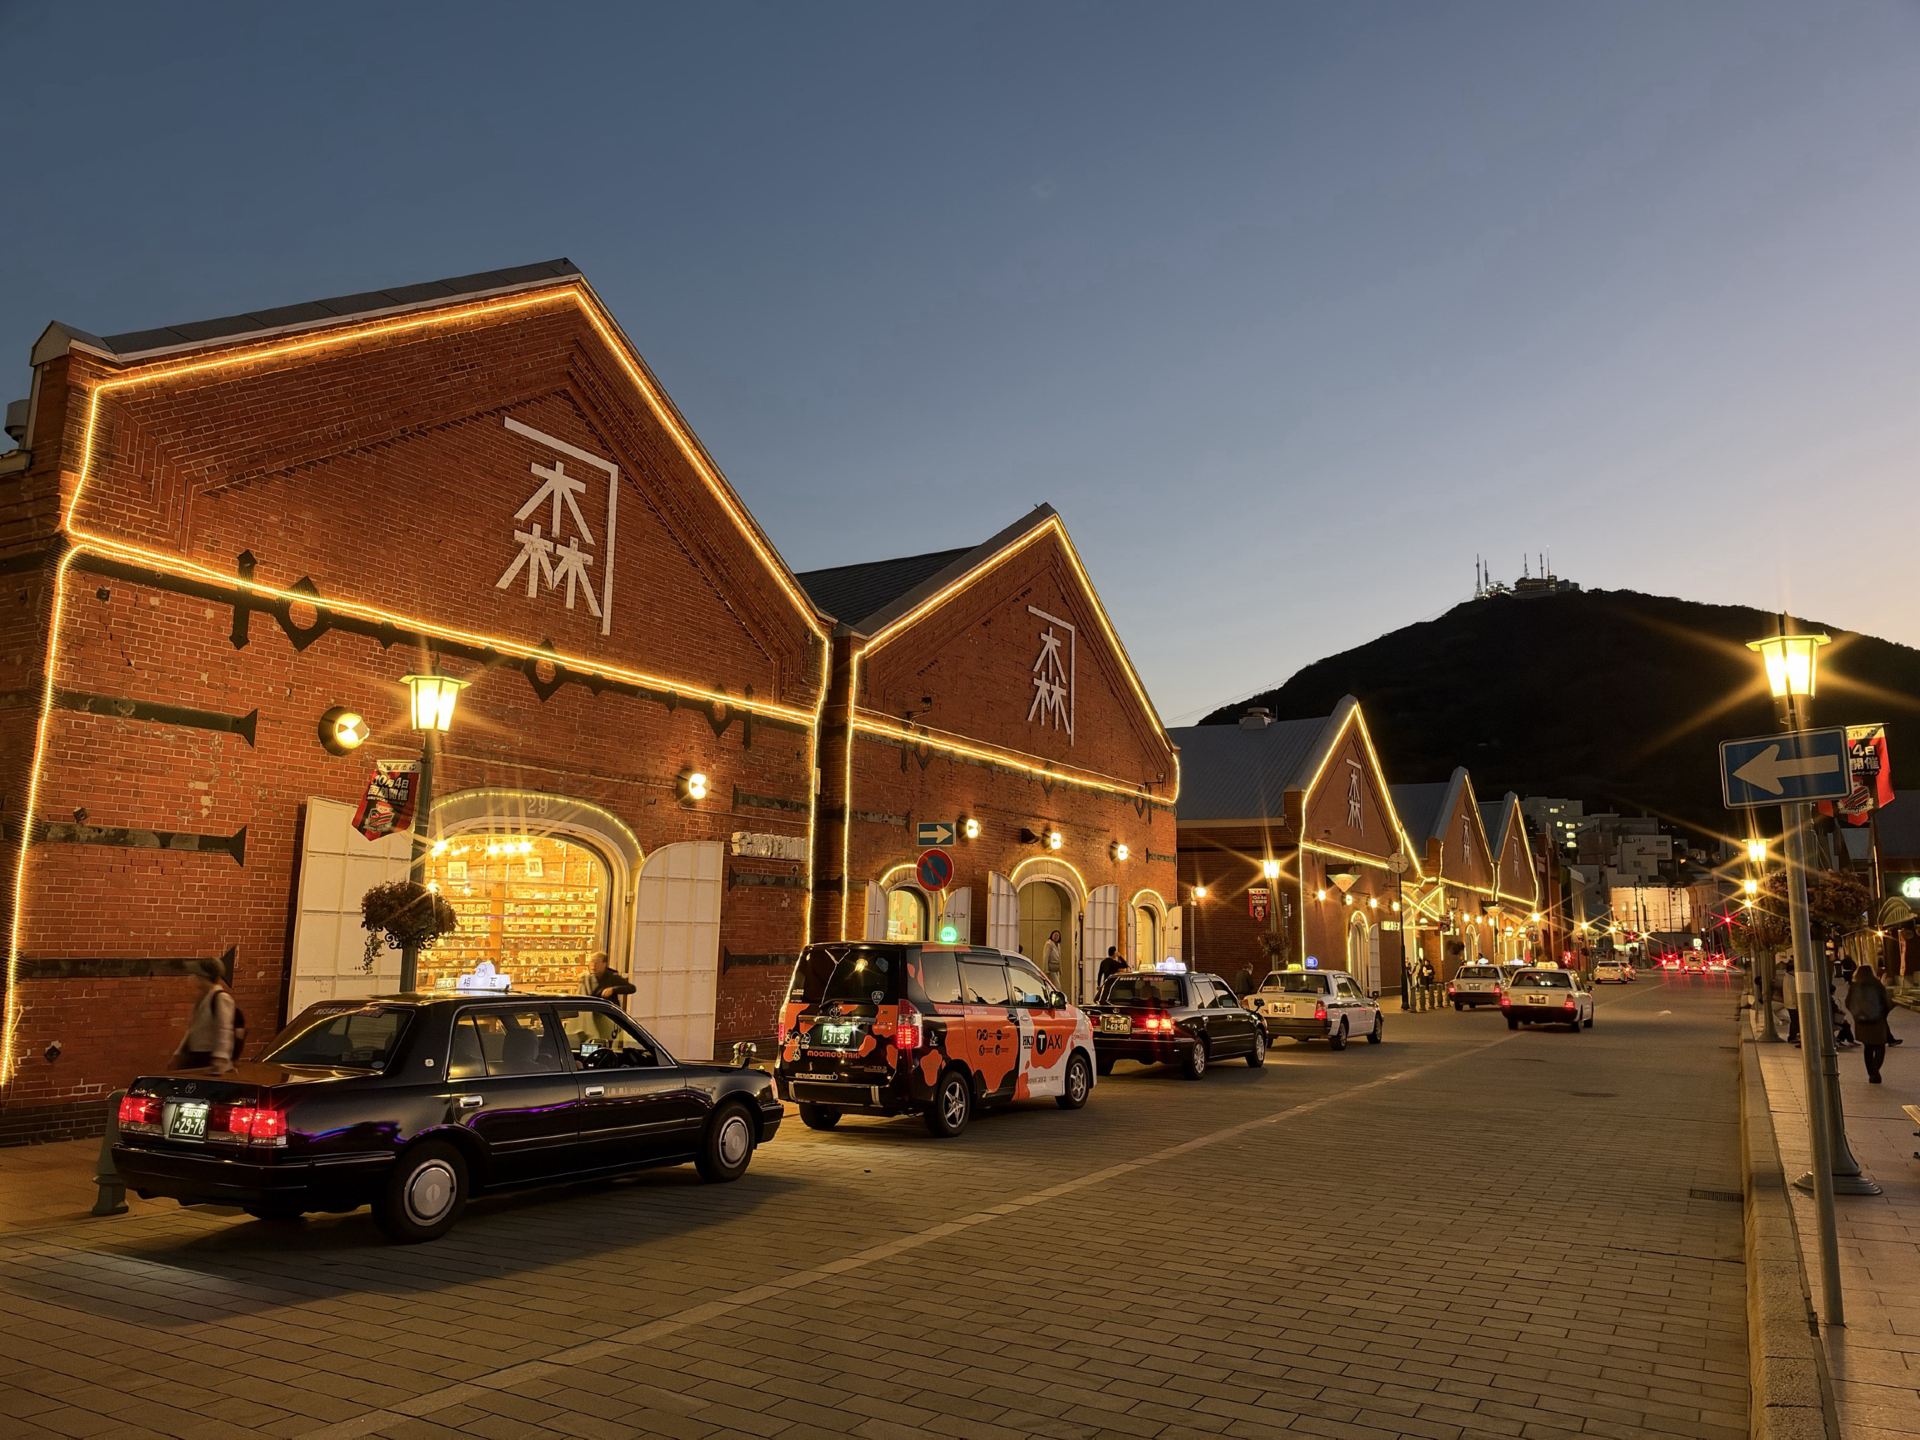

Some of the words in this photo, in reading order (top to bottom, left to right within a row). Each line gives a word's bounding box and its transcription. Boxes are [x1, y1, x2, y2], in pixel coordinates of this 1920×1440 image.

[527, 797, 549, 815] 29
[827, 1033, 850, 1044] 31-95
[179, 1118, 206, 1135] 29-78
